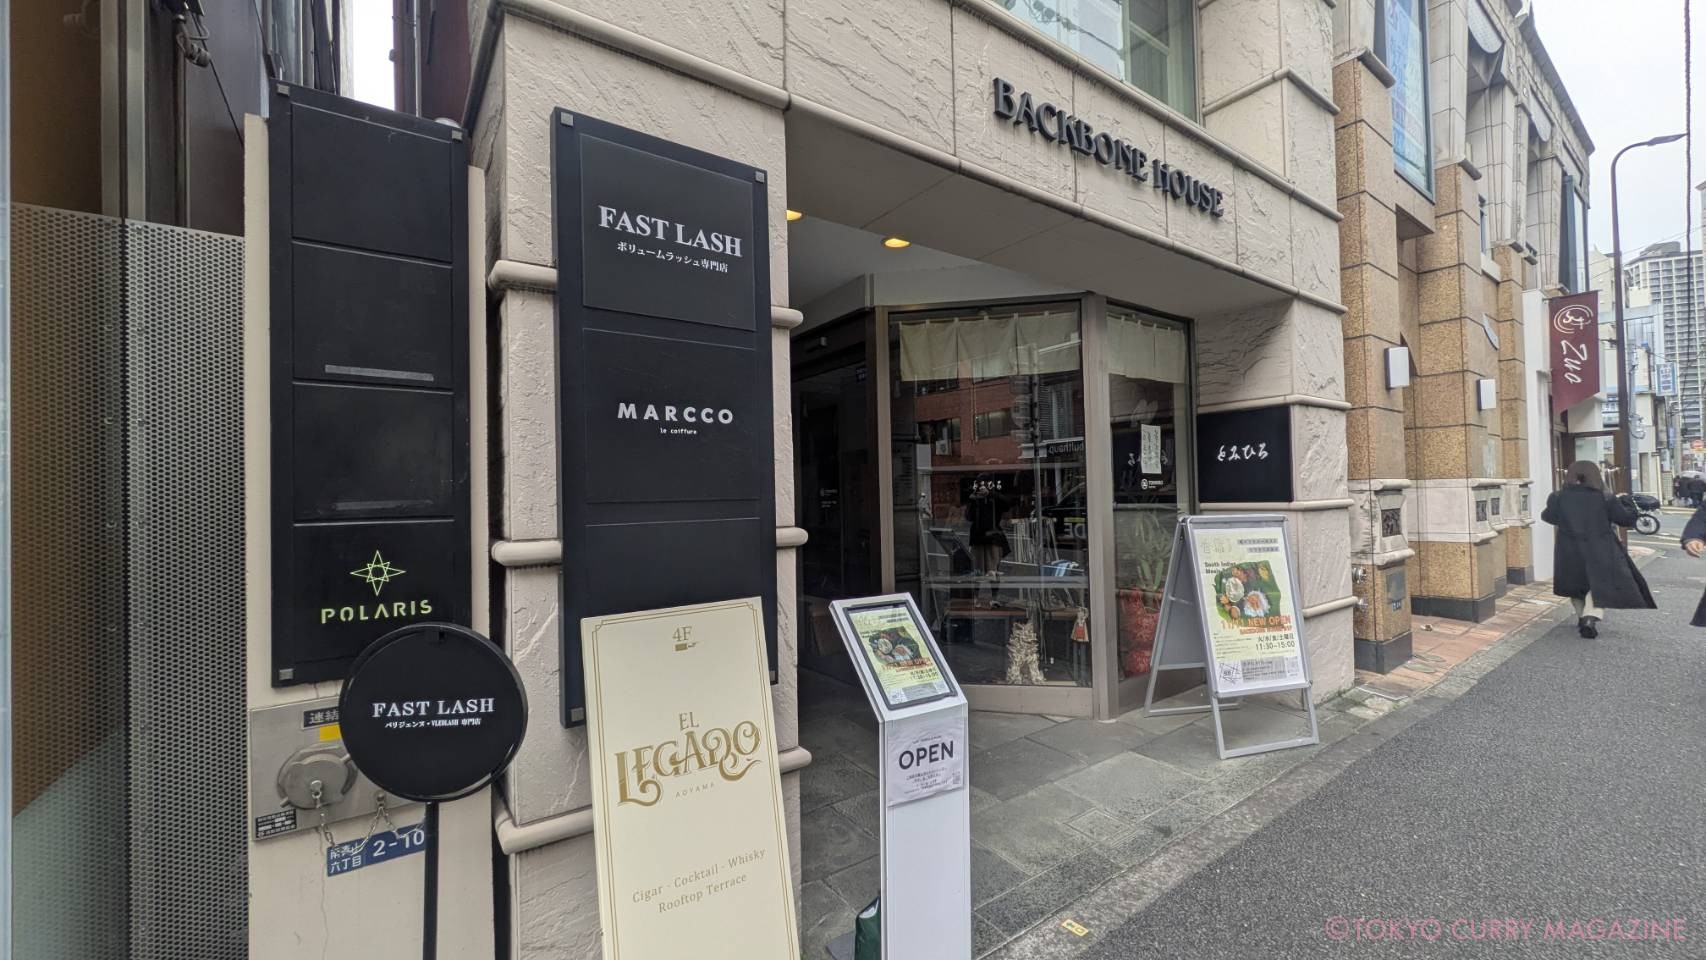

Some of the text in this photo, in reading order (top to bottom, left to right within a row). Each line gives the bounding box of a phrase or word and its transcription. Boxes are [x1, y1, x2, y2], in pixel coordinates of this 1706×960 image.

[992, 76, 1224, 218] BACKBONE HOUSE
[599, 205, 743, 258] FAST LASH
[617, 241, 729, 273] ボリュームラッシュ専門店
[618, 403, 733, 424] MARCCO
[321, 600, 433, 624] POLARIS
[672, 626, 693, 643] 4F
[372, 697, 495, 718] FAST LASH
[678, 711, 700, 731] EL
[614, 720, 762, 807] LEGADO
[898, 740, 954, 770] OPEN
[675, 781, 715, 799] AOYAMA
[330, 855, 362, 874] 六丁目
[632, 848, 767, 904] Cigar Cocktail Whisky
[658, 873, 747, 914] Rooftop Terrace
